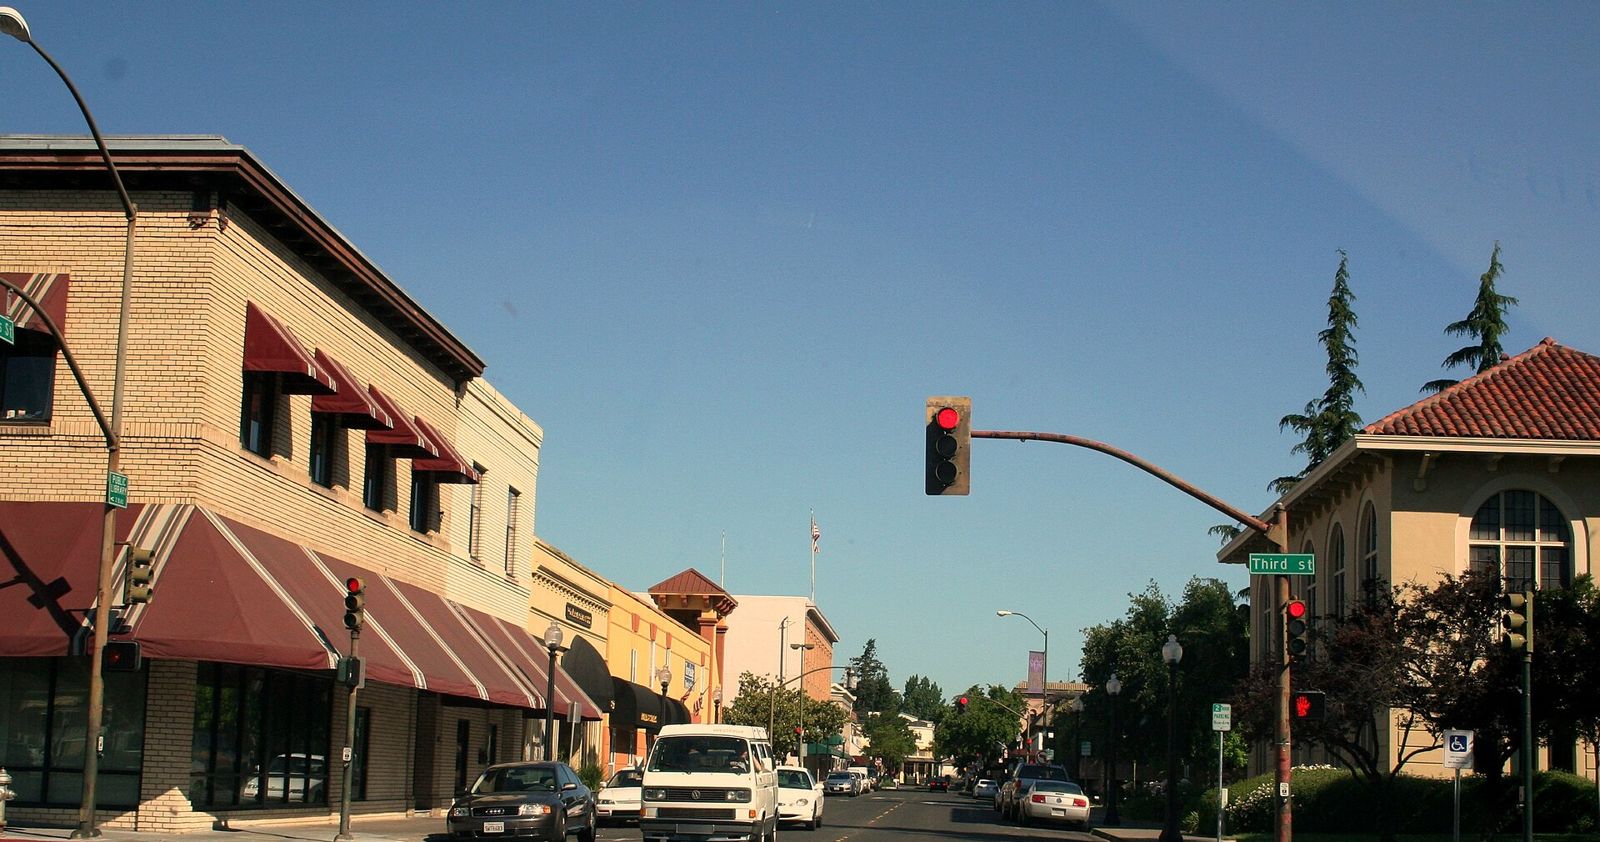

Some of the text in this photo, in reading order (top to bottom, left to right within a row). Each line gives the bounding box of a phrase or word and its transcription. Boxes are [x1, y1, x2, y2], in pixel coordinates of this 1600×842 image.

[111, 474, 127, 487] PUBLIC
[110, 483, 127, 496] LIBRARY
[1252, 558, 1287, 570] Third
